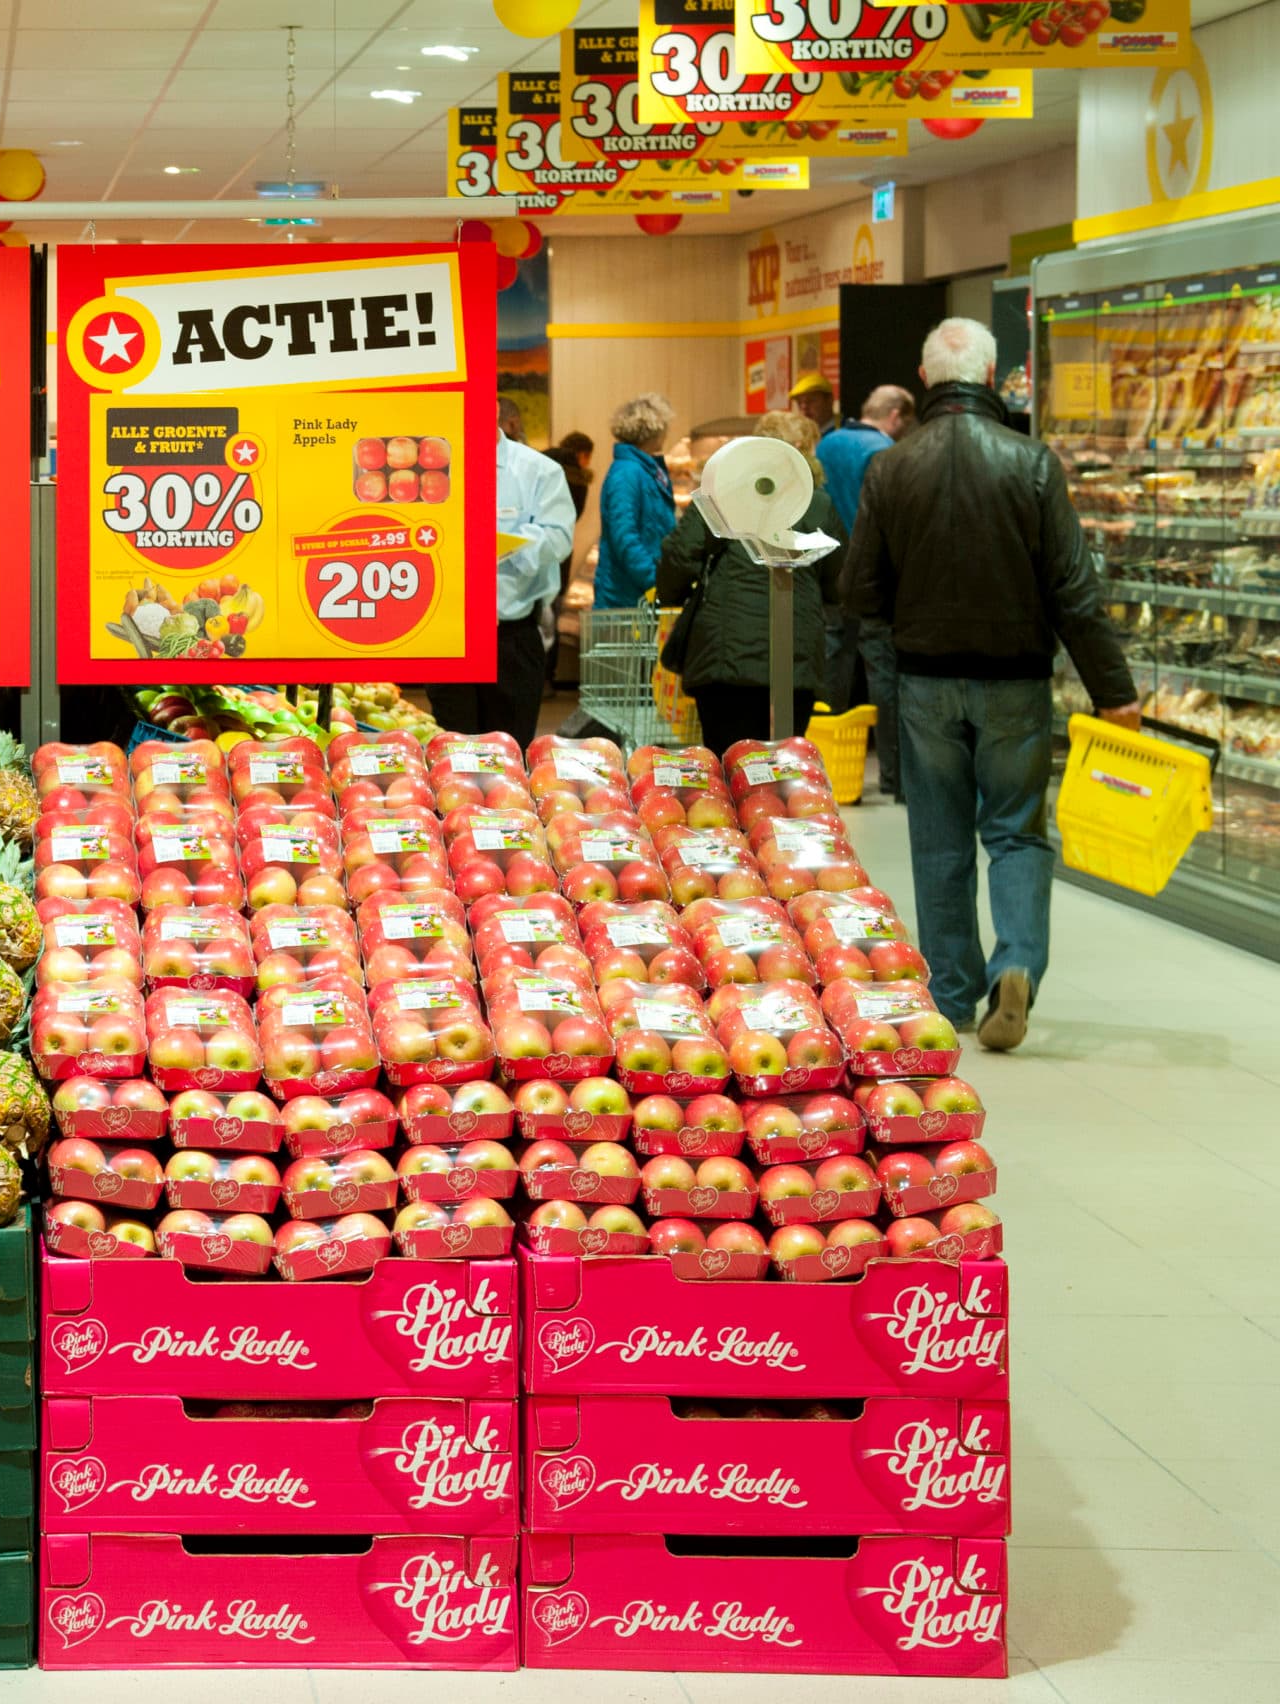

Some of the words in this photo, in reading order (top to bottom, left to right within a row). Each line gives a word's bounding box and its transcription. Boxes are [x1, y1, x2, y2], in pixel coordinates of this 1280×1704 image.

[701, 0, 734, 10] FRU
[578, 37, 617, 49] ALLE
[791, 39, 913, 60] KORTING
[512, 80, 546, 91] ALLE
[686, 93, 792, 112] KORTING
[462, 115, 492, 125] ALLE
[603, 134, 697, 153] KORTING
[534, 168, 617, 184] KORTING
[518, 195, 557, 208] TING
[748, 244, 780, 305] KIP
[172, 292, 436, 365] ACTIE!
[111, 426, 150, 438] ALLE
[154, 426, 226, 438] GROENTE
[293, 419, 322, 430] Pink
[326, 419, 358, 433] Lady
[134, 441, 146, 453] &
[293, 433, 336, 447] Appels
[102, 471, 263, 532] 30%
[136, 531, 234, 548] KORTING
[368, 532, 407, 547] 2.99
[318, 560, 419, 619] 2.09
[374, 1278, 498, 1336] Pink
[867, 1275, 991, 1339] Pink
[59, 1326, 94, 1350] Pink
[108, 1326, 219, 1364] Pink
[408, 1316, 512, 1372] Lady
[547, 1325, 582, 1348] Pink
[595, 1326, 707, 1363] Pink
[899, 1319, 1006, 1375] Lady
[67, 1340, 100, 1359] Lady
[554, 1338, 587, 1359] Lady
[371, 1416, 498, 1474] Pink
[866, 1415, 990, 1476] Pink
[58, 1465, 93, 1488] Pink
[107, 1463, 217, 1501] Pink
[407, 1455, 512, 1510] Lady
[548, 1464, 583, 1487] Pink
[556, 1477, 589, 1497] Lady
[596, 1463, 708, 1500] Pink
[899, 1455, 1006, 1511] Lady
[66, 1478, 99, 1498] Lady
[371, 1551, 499, 1608] Pink
[859, 1554, 987, 1612] Pink
[57, 1602, 92, 1625] Pink
[105, 1599, 216, 1637] Pink
[406, 1588, 511, 1645] Lady
[541, 1599, 576, 1622] Pink
[590, 1599, 702, 1637] Pink
[64, 1615, 97, 1635] Lady
[549, 1612, 582, 1633] Lady
[896, 1598, 1001, 1651] Lady
